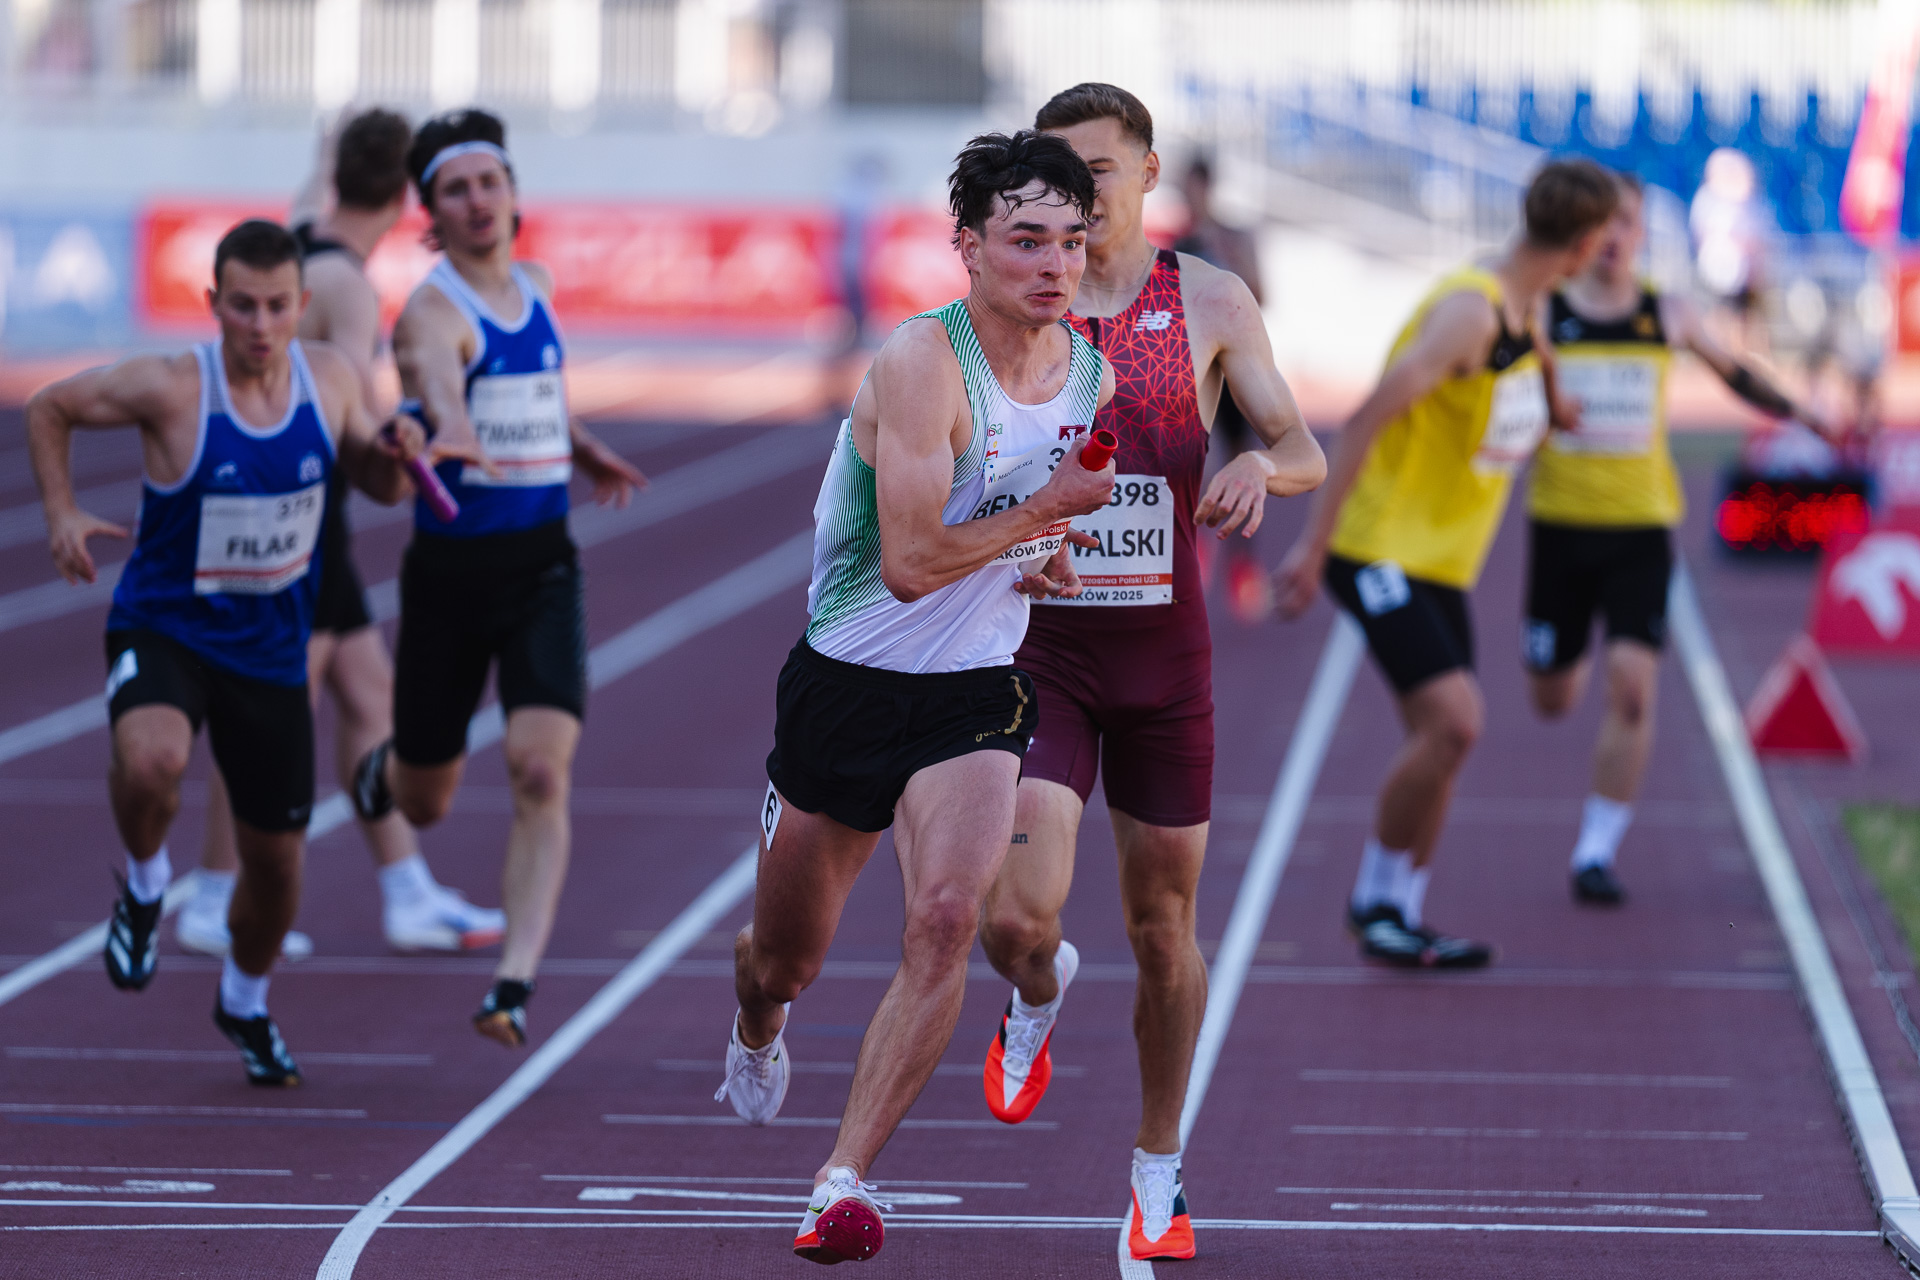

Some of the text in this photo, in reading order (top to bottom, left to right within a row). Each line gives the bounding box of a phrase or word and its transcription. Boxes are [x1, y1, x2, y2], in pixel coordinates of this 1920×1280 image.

[1081, 575, 1159, 585] trzostwa Polski U23
[1112, 590, 1144, 601] 2025
[765, 791, 777, 834] 6
[1010, 833, 1029, 844] un
